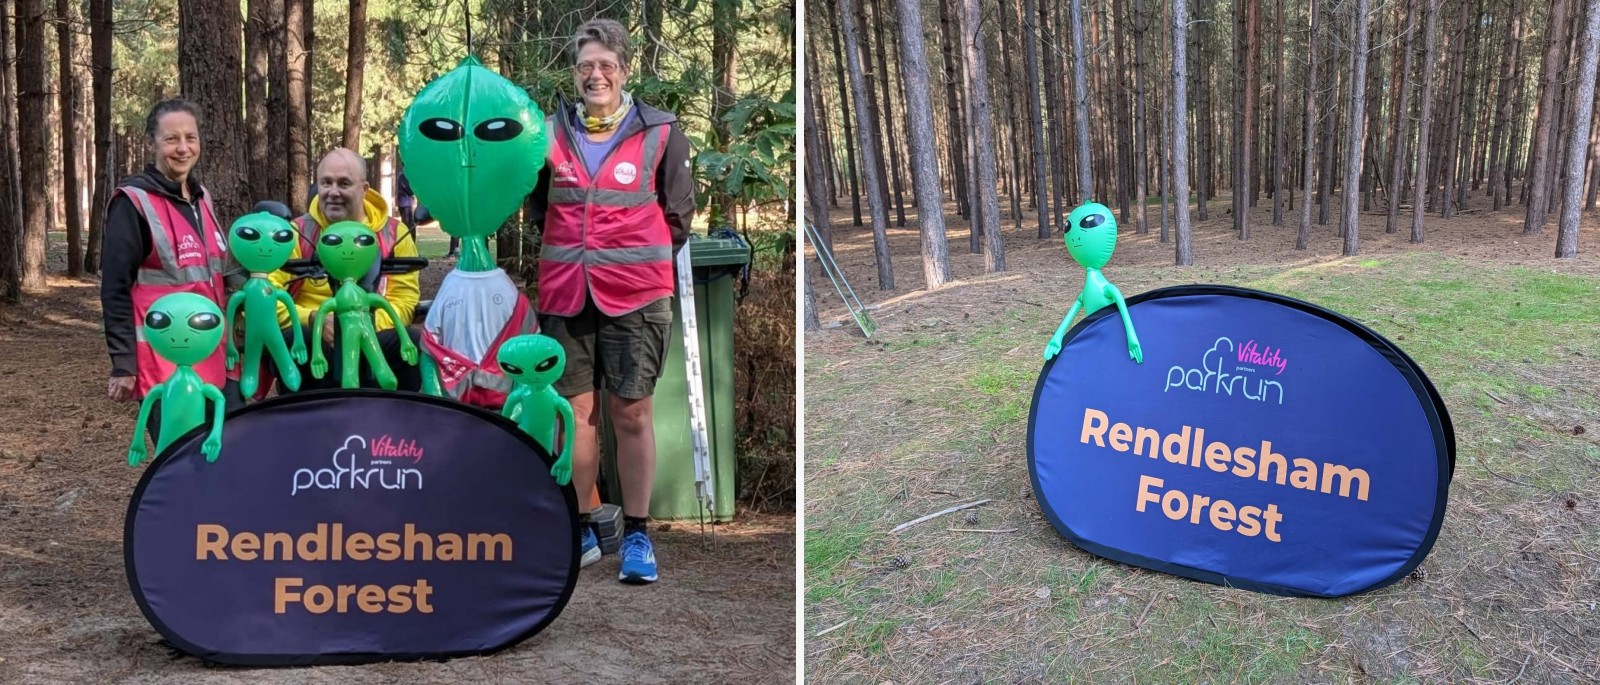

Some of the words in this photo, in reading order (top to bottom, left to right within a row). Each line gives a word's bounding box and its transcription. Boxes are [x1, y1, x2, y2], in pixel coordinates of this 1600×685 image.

[1238, 339, 1288, 375] Vitality
[1164, 354, 1284, 405] parkrun
[371, 434, 424, 464] Vitality
[1080, 408, 1370, 502] Rendlesham
[291, 453, 423, 496] parkrun
[1135, 474, 1283, 543] Forest
[195, 523, 513, 561] Rendlesham
[274, 577, 434, 614] Forest
